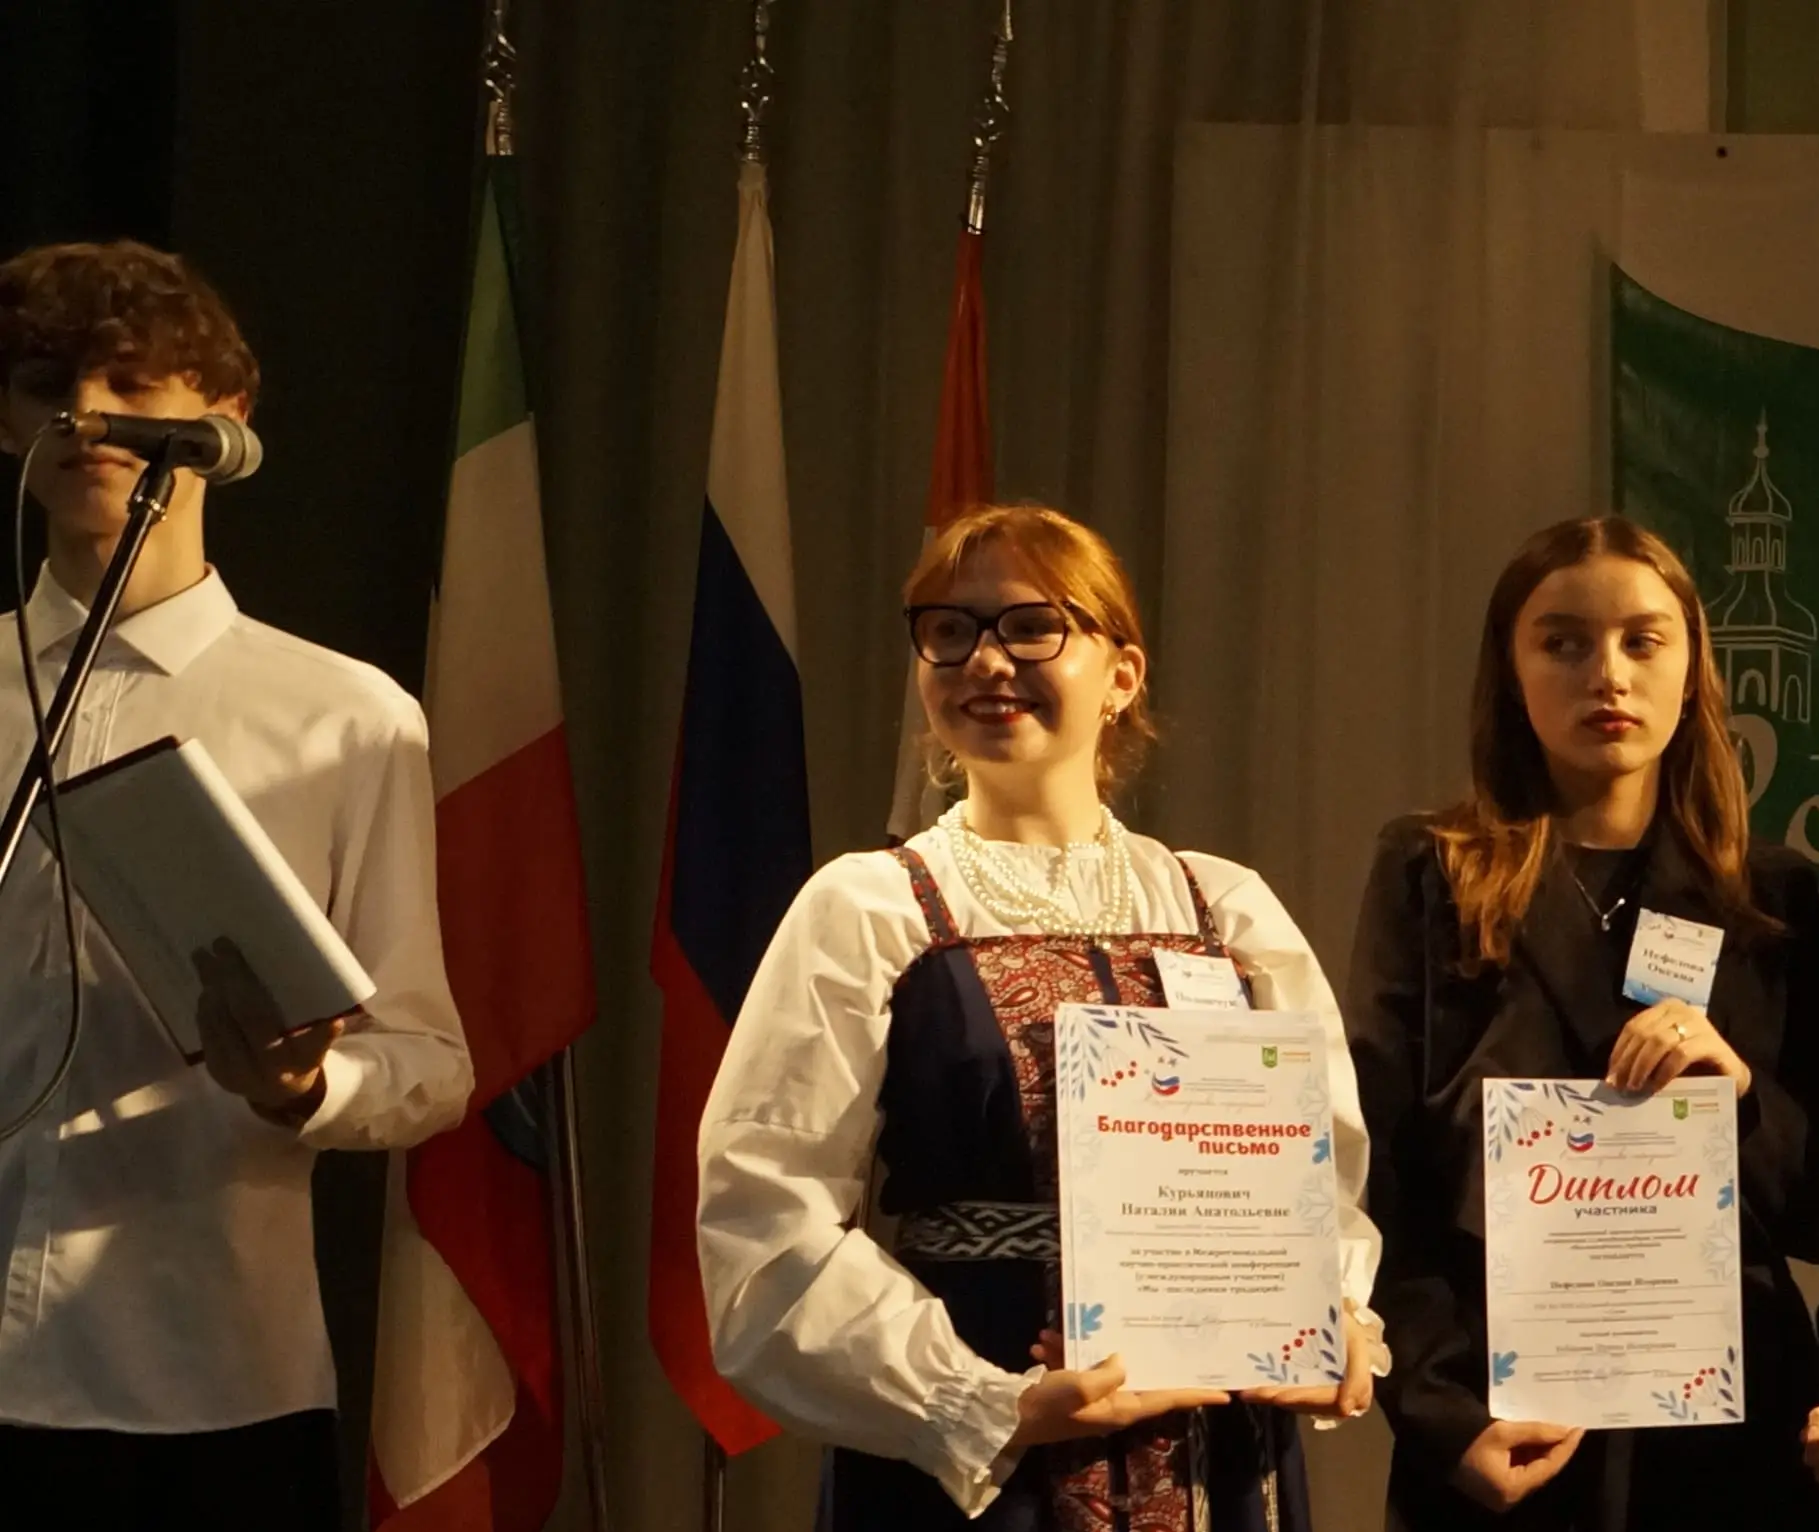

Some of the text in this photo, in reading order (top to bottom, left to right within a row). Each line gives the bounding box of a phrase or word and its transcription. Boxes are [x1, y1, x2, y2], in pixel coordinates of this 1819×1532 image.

[1097, 1115, 1312, 1142] Благодарственное
[1198, 1139, 1281, 1156] письмо
[1527, 1163, 1701, 1205] Диплом
[1573, 1204, 1659, 1220] участника
